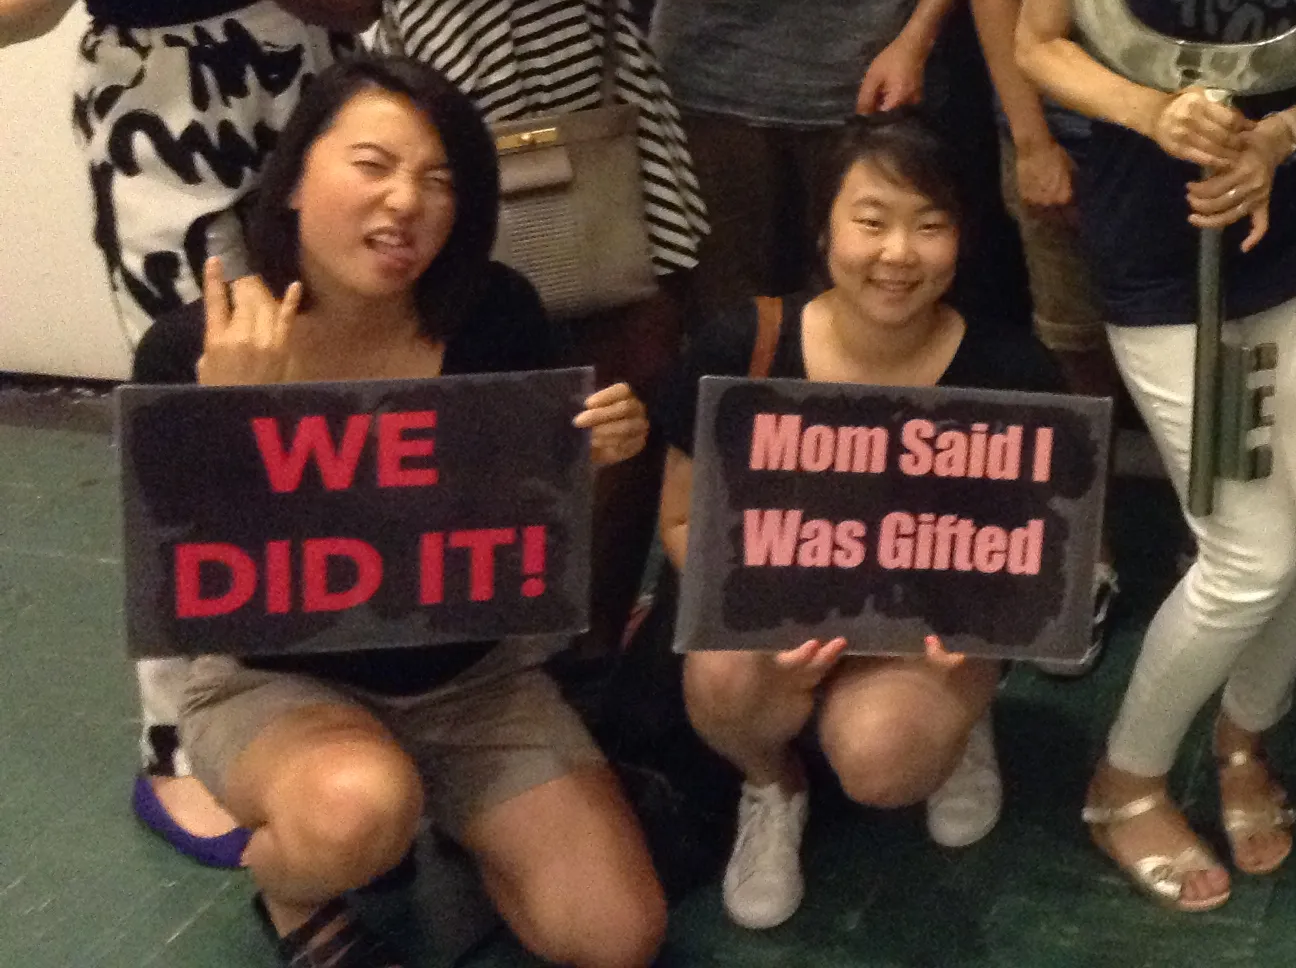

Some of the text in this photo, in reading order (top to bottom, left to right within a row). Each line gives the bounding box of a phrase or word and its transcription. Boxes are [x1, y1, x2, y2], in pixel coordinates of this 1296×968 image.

[251, 410, 439, 493] WE
[749, 413, 1053, 482] Mom Said I
[174, 525, 546, 619] DID IT!
[743, 509, 1045, 575] Was Gifted
